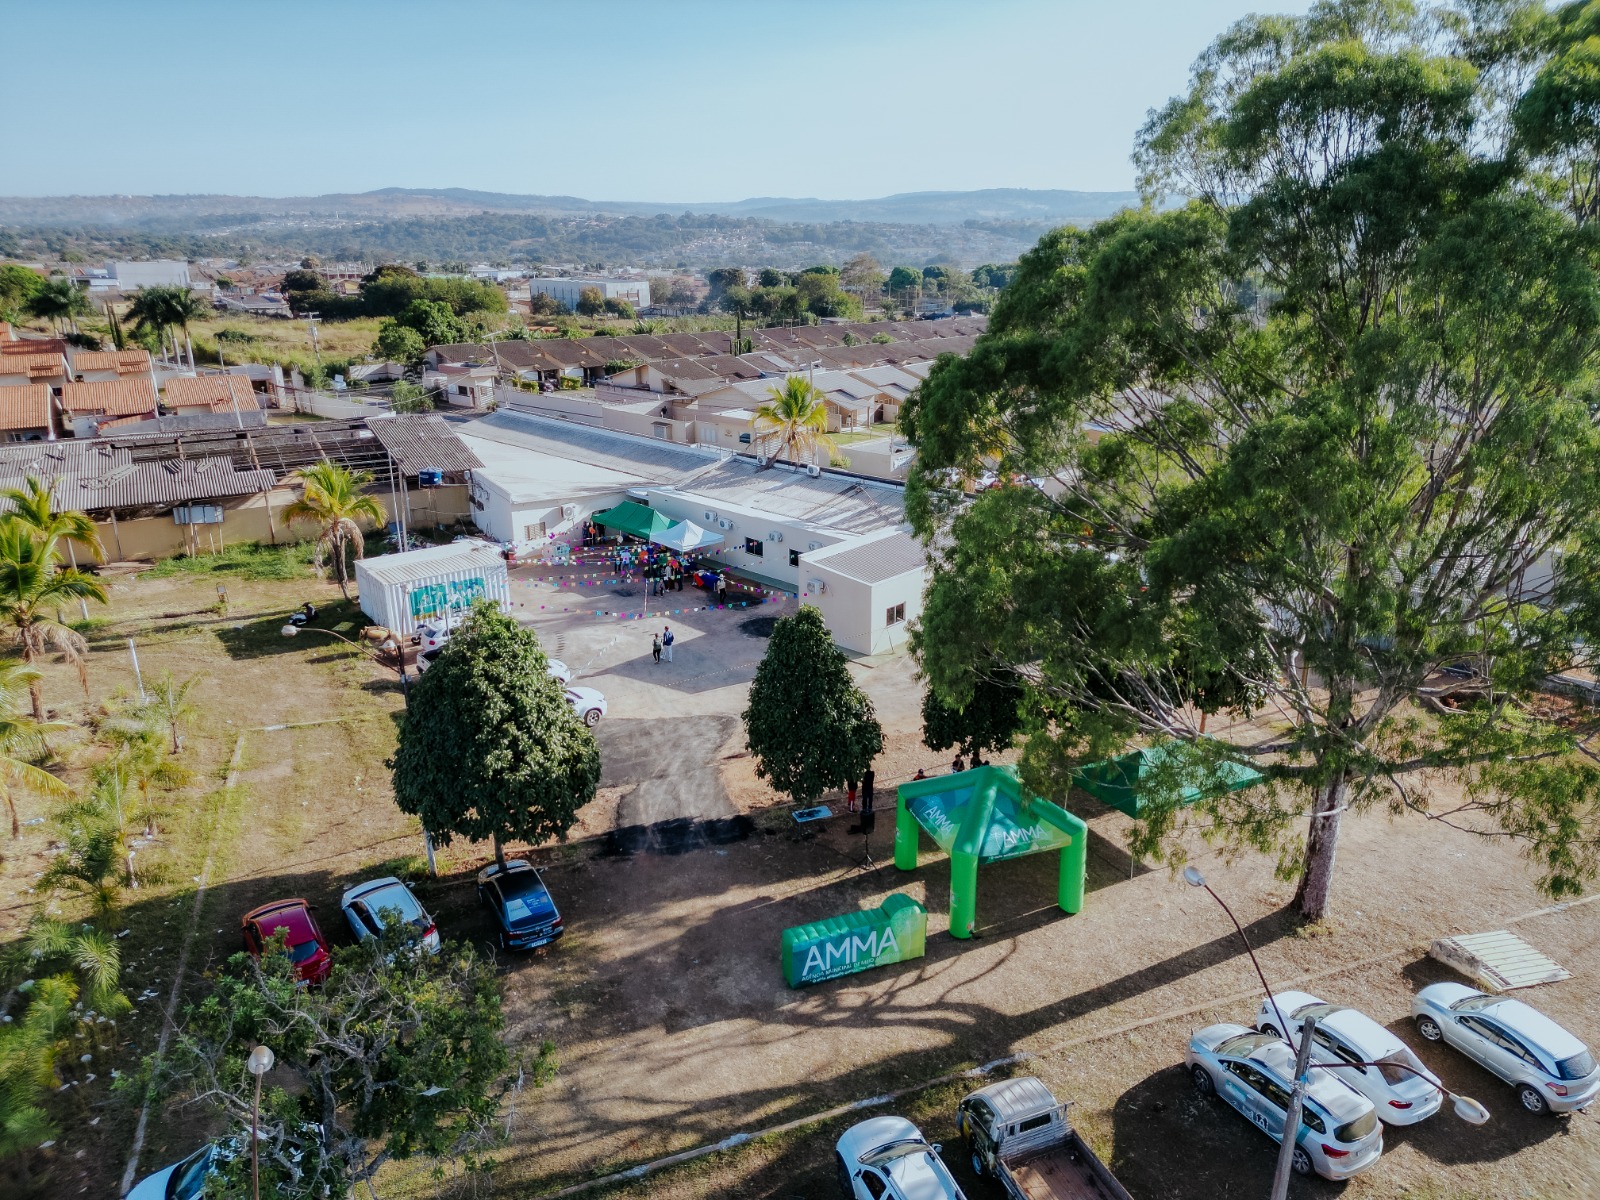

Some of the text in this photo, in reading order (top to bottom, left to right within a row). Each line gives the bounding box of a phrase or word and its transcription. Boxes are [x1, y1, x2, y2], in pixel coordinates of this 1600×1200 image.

[925, 806, 955, 834] AMMA
[1003, 824, 1048, 848] AMMA
[802, 927, 899, 976] AMMA
